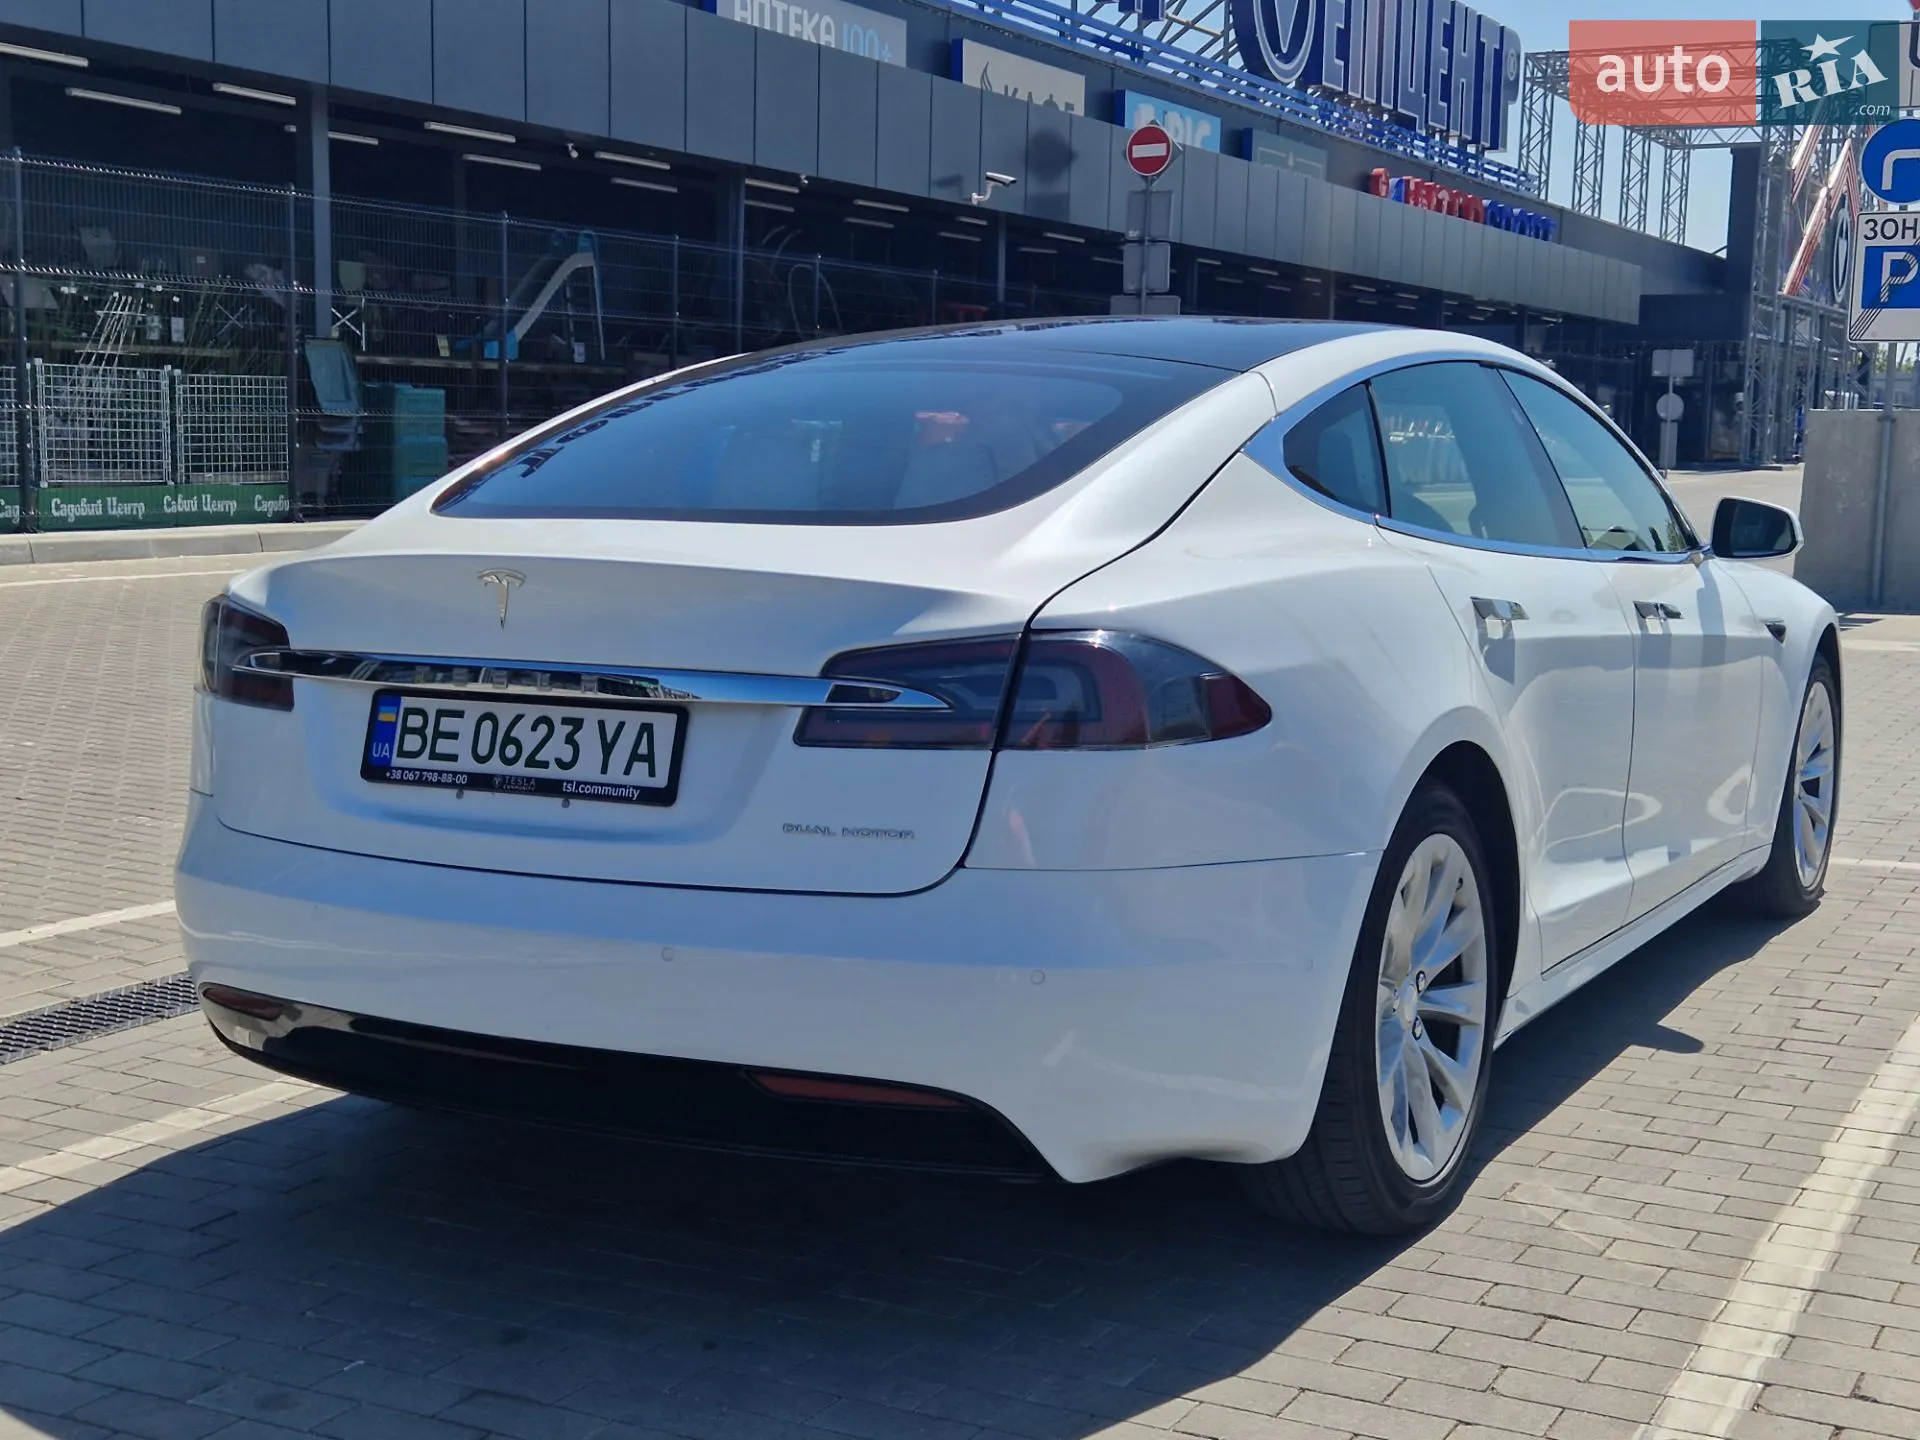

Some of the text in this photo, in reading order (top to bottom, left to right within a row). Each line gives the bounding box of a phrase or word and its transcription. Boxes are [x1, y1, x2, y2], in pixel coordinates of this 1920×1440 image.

[51, 496, 146, 522] Садовий Центр
[201, 494, 237, 516] Центр
[372, 742, 390, 758] UA
[396, 707, 657, 778] BE 0623 YA
[385, 770, 468, 785] +38 067 798-88-00
[505, 775, 536, 787] TESLA
[562, 780, 640, 801] tsl.community
[782, 822, 915, 840] DUAL MOTOR
